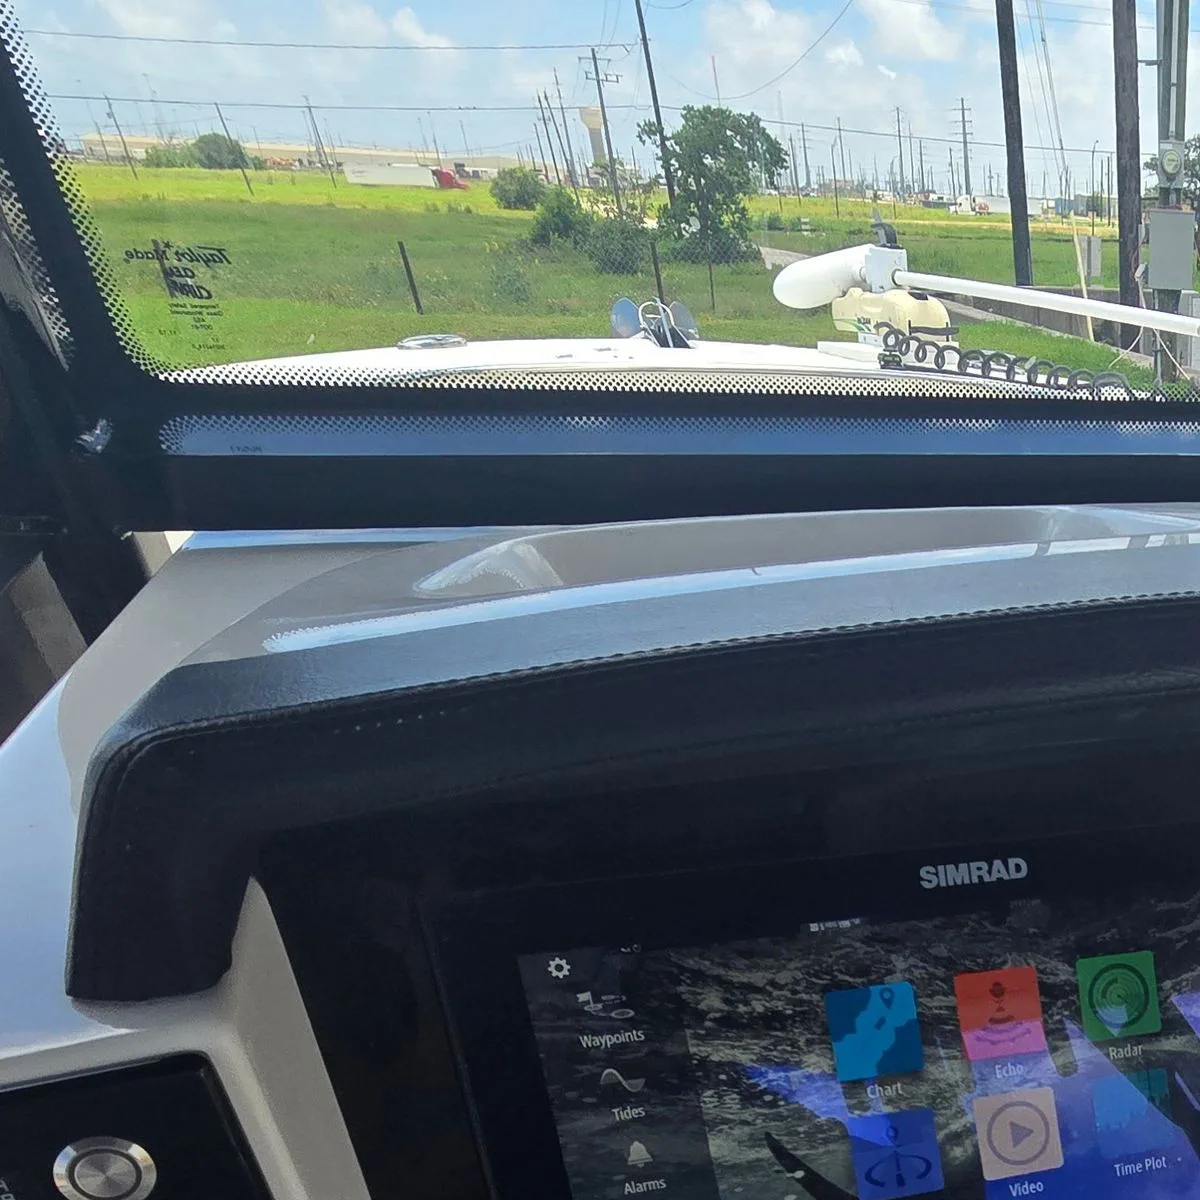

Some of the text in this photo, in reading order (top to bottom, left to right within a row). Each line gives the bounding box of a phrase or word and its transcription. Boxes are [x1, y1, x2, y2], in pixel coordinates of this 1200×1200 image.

[919, 857, 1028, 890] SIMRAD
[579, 1028, 645, 1049] Waypoints
[1108, 1042, 1143, 1060] Radar
[994, 1062, 1024, 1079] Echo
[866, 1082, 902, 1099] Chart
[612, 1104, 646, 1121] Tides
[1113, 1155, 1167, 1178] Time Plot
[623, 1176, 667, 1195] Alarms
[1008, 1179, 1044, 1197] Video
